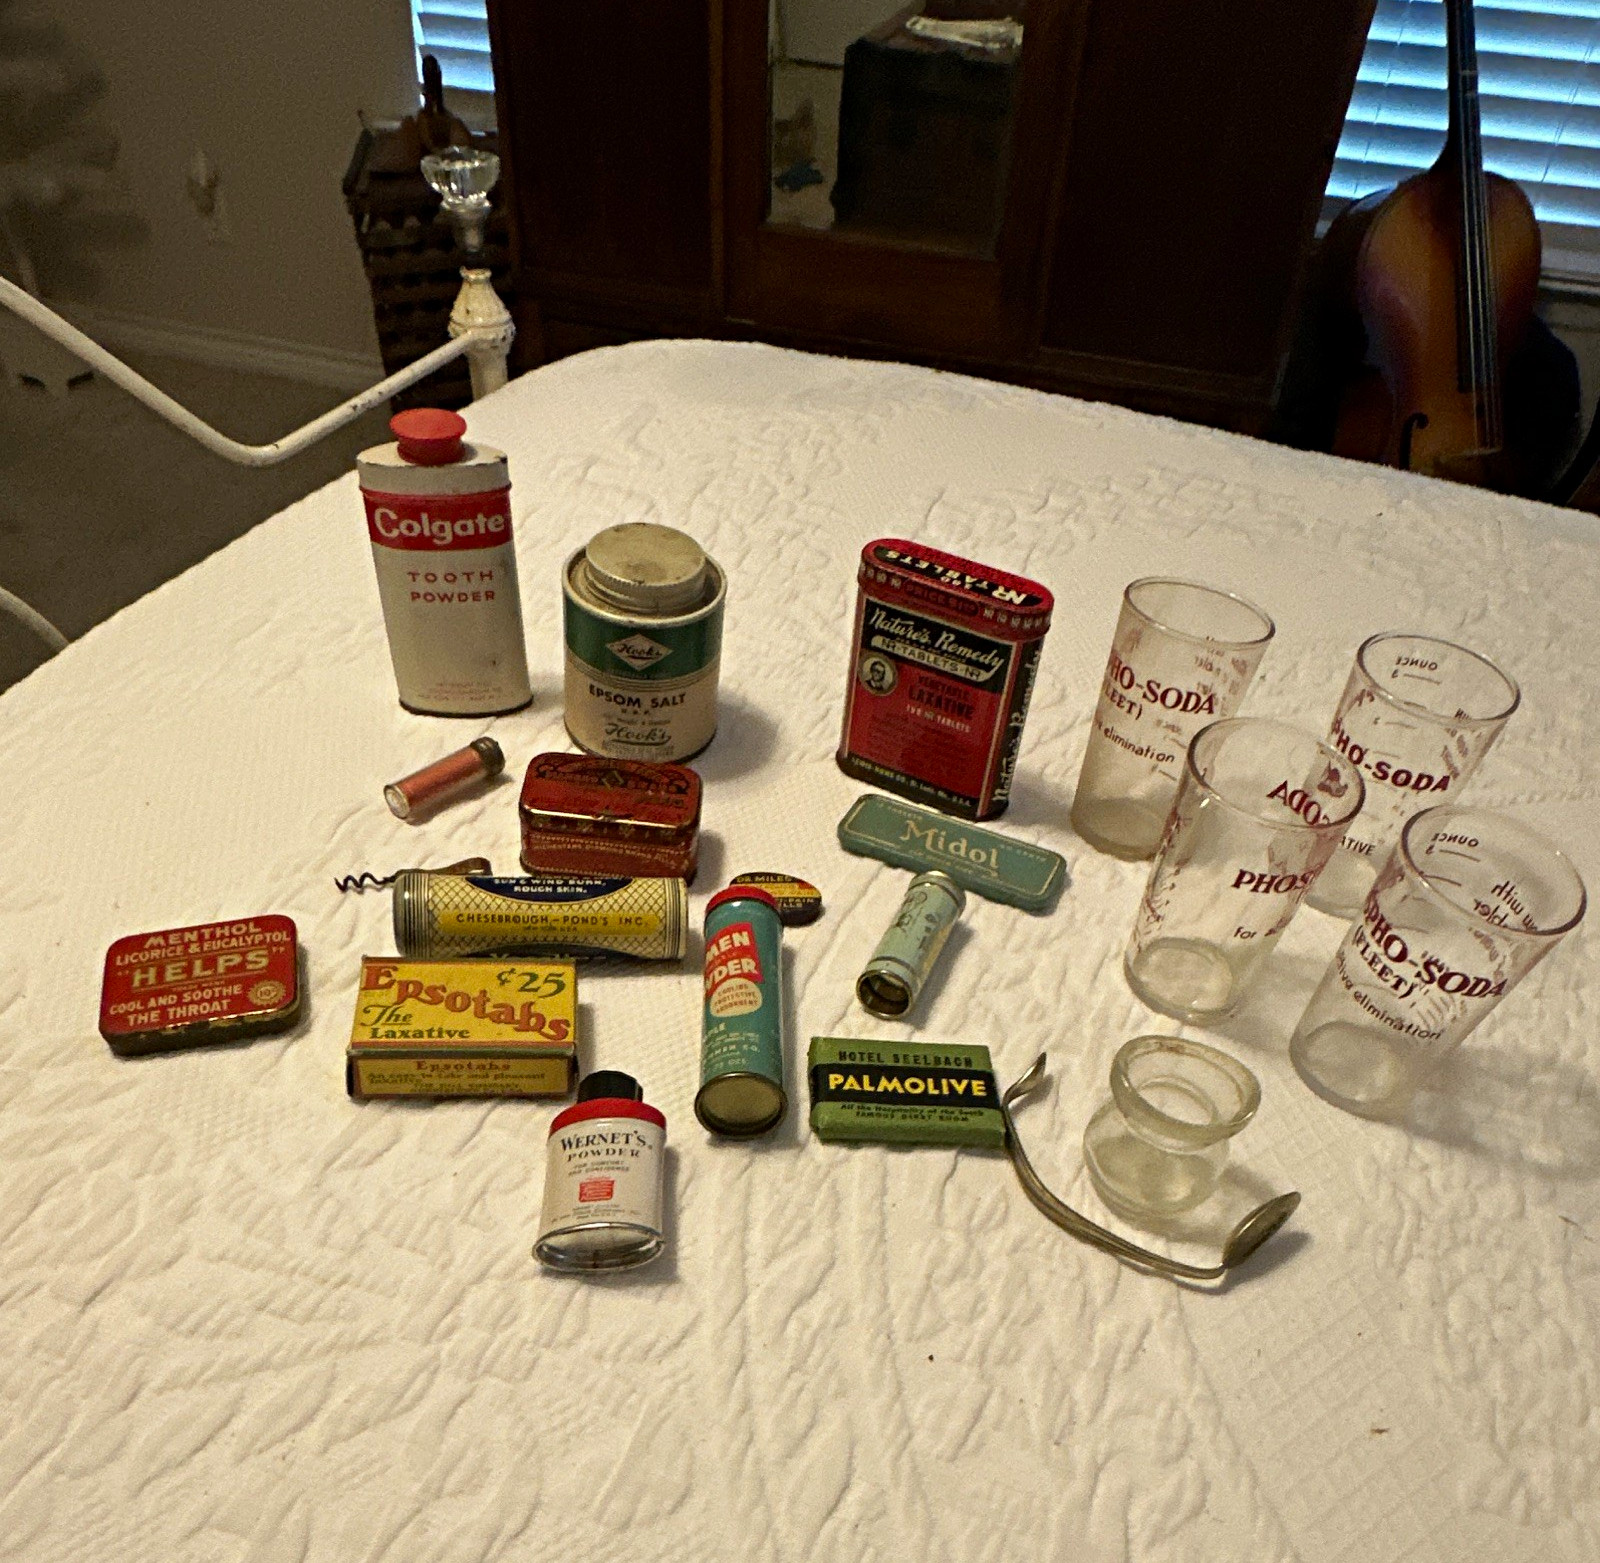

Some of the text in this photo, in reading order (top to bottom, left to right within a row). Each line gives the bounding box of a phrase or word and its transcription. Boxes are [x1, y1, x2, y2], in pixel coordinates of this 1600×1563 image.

[374, 508, 504, 545] Colgate
[408, 569, 493, 583] TOOTH
[411, 590, 495, 603] POWDER
[869, 608, 931, 644] Nature's
[935, 631, 1004, 667] Remedy
[588, 683, 686, 708] EPSOM SALT
[1109, 655, 1215, 714] HO-SODA
[1104, 682, 1142, 720] LEET)
[1104, 726, 1175, 764] elimination
[900, 820, 999, 869] Midol
[144, 921, 262, 948] MENTHOL
[619, 915, 648, 927] INC.
[115, 930, 291, 966] LICORICE & EUCALYPTOL
[109, 1000, 144, 1015] COOL
[148, 995, 177, 1008] AND
[182, 984, 243, 1003] SOOTHE
[127, 999, 231, 1027] THE THROAT
[361, 965, 571, 1040] Epsotabs
[360, 1004, 413, 1026] The
[1354, 991, 1445, 1040] elimination
[370, 1027, 471, 1039] Laxative
[415, 1061, 511, 1073] Epsotabs
[838, 1051, 973, 1067] HOTEL SEELBACH
[828, 1073, 987, 1097] PALMOLIVE
[561, 1131, 646, 1150] WERNET'S
[567, 1148, 640, 1162] POWDER
